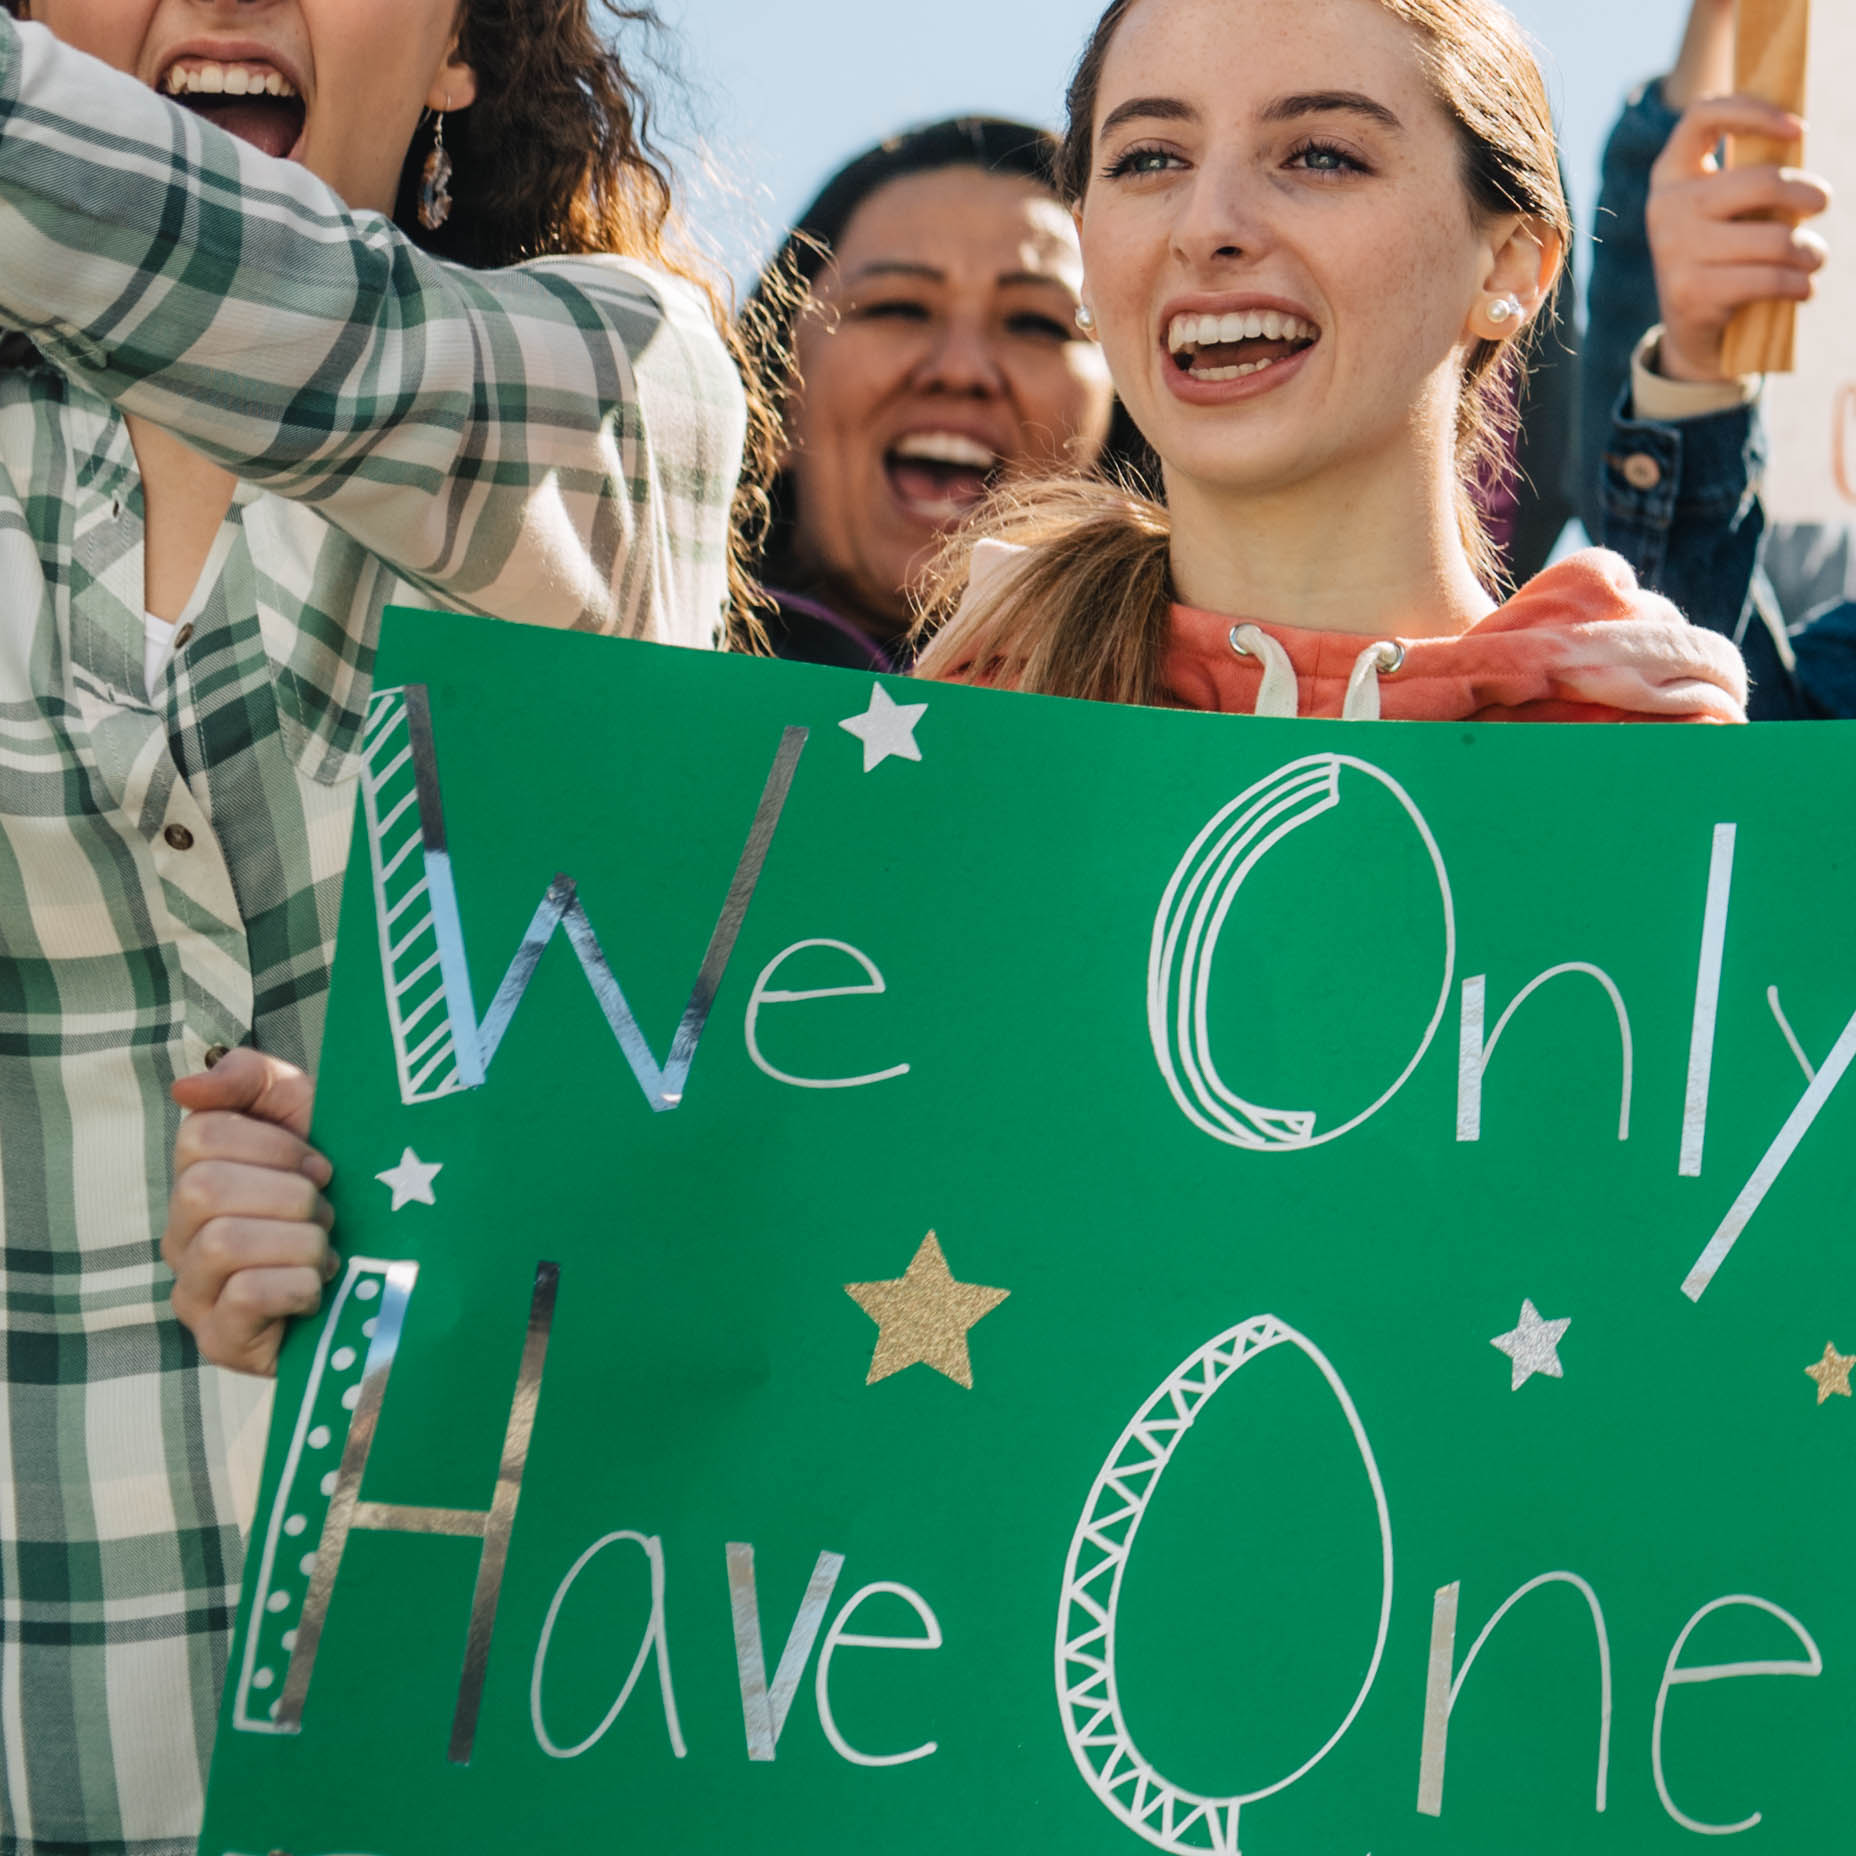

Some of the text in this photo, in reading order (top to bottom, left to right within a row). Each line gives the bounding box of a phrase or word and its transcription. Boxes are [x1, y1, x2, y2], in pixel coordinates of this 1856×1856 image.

[362, 682, 912, 1114] We
[231, 1256, 1823, 1856] Have One
